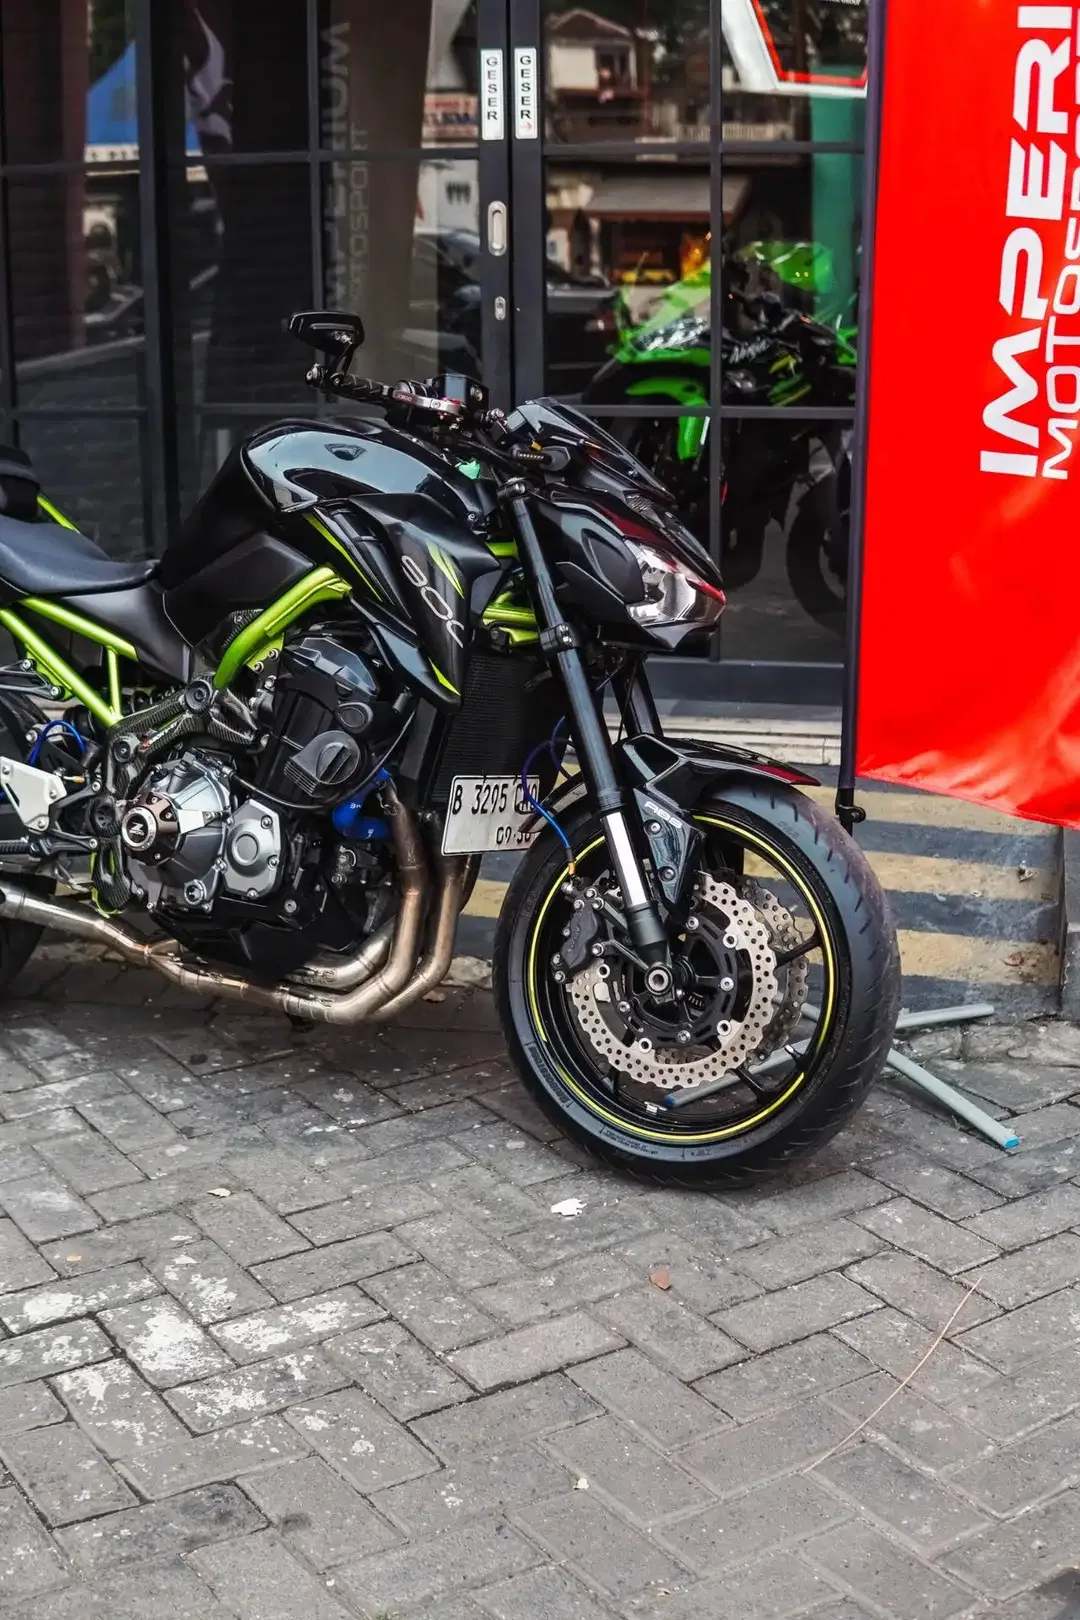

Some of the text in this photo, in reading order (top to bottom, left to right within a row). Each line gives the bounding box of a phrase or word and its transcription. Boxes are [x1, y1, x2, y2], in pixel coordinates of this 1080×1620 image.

[486, 56, 498, 120] GESER
[520, 55, 532, 119] GESER
[979, 6, 1072, 477] IMPERI
[452, 784, 463, 815] B
[471, 783, 508, 815] 3295
